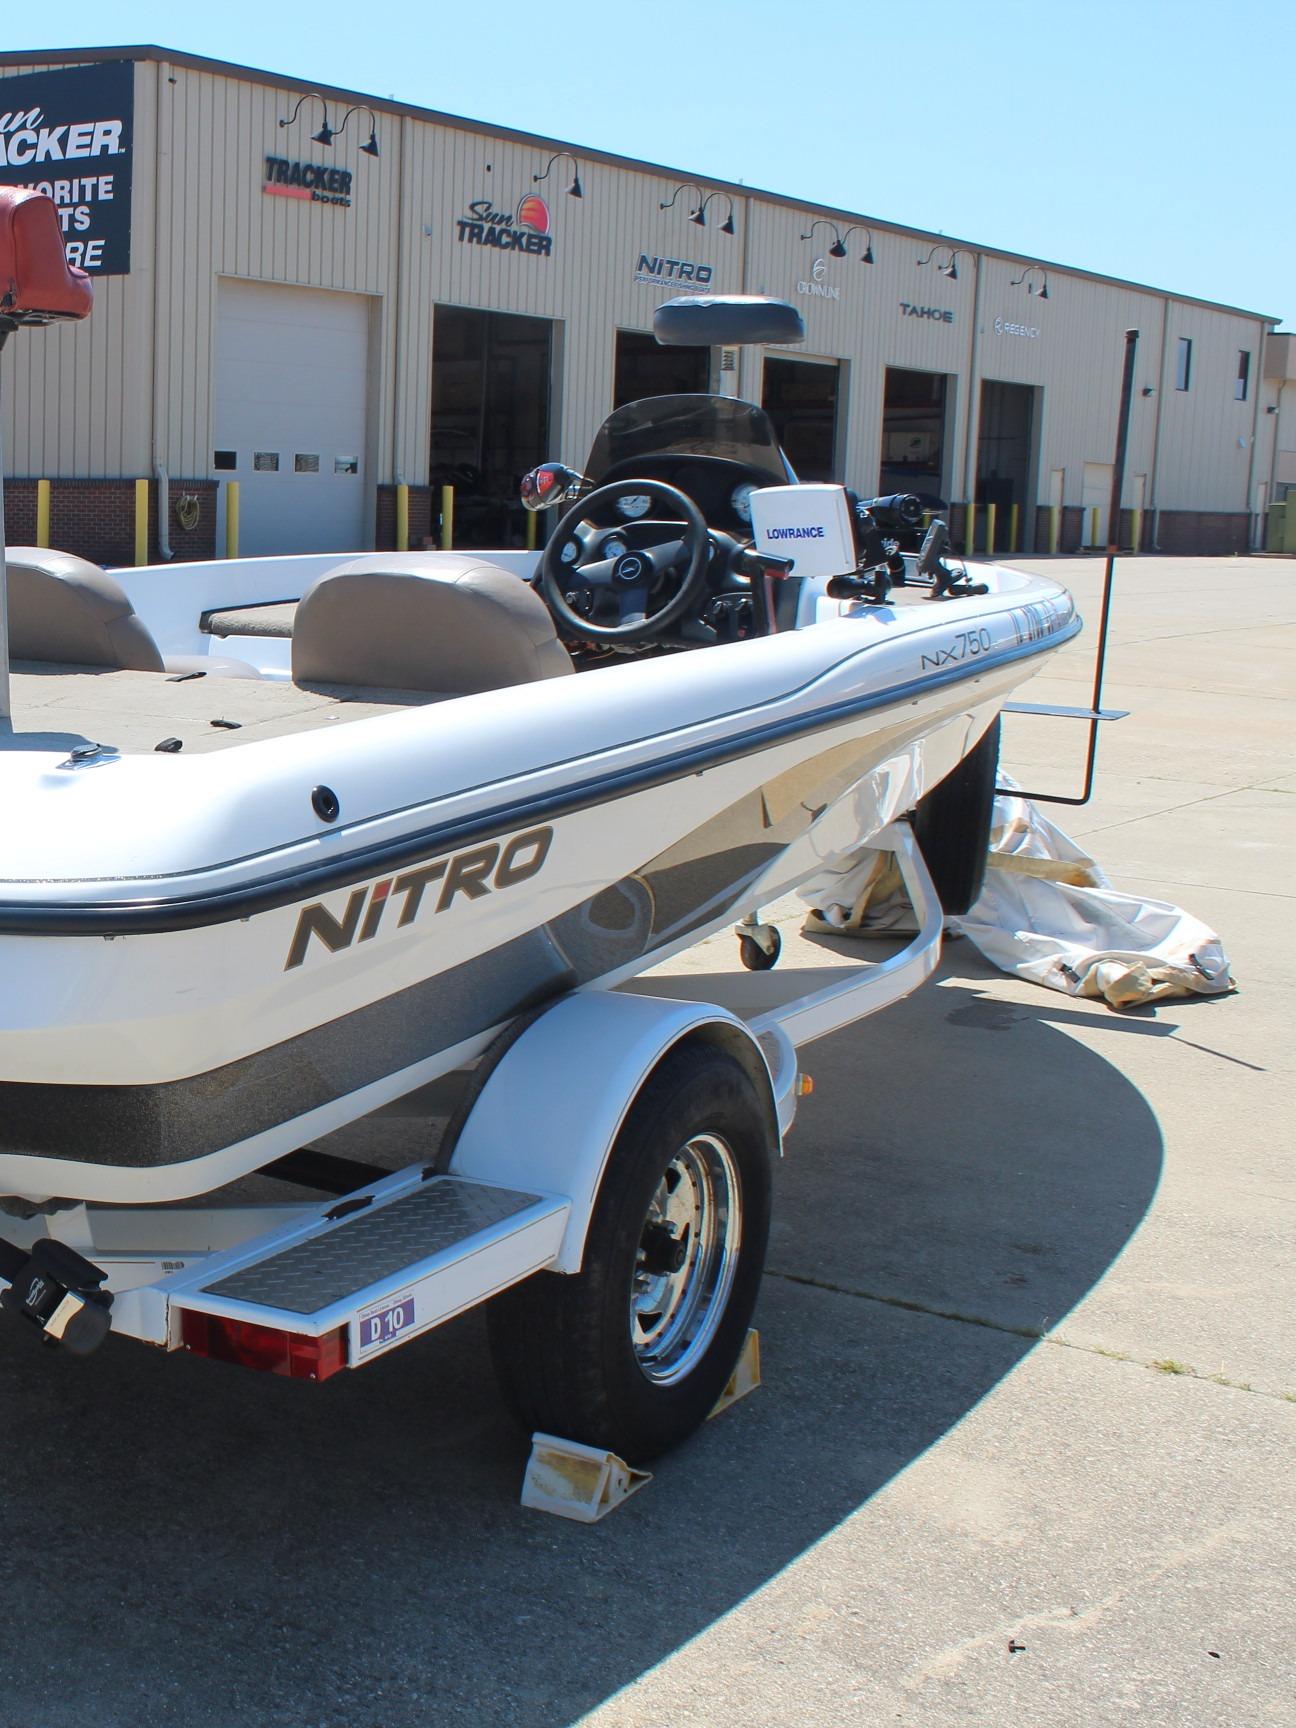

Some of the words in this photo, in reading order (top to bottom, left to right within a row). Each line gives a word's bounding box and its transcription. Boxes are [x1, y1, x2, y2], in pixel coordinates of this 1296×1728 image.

[265, 156, 353, 196] TRACKER
[311, 191, 352, 207] boats
[466, 201, 514, 227] Sun
[457, 219, 552, 257] TRACKER
[899, 303, 953, 323] TAHOE
[766, 526, 825, 540] LOWRANCE
[920, 627, 991, 670] NX750
